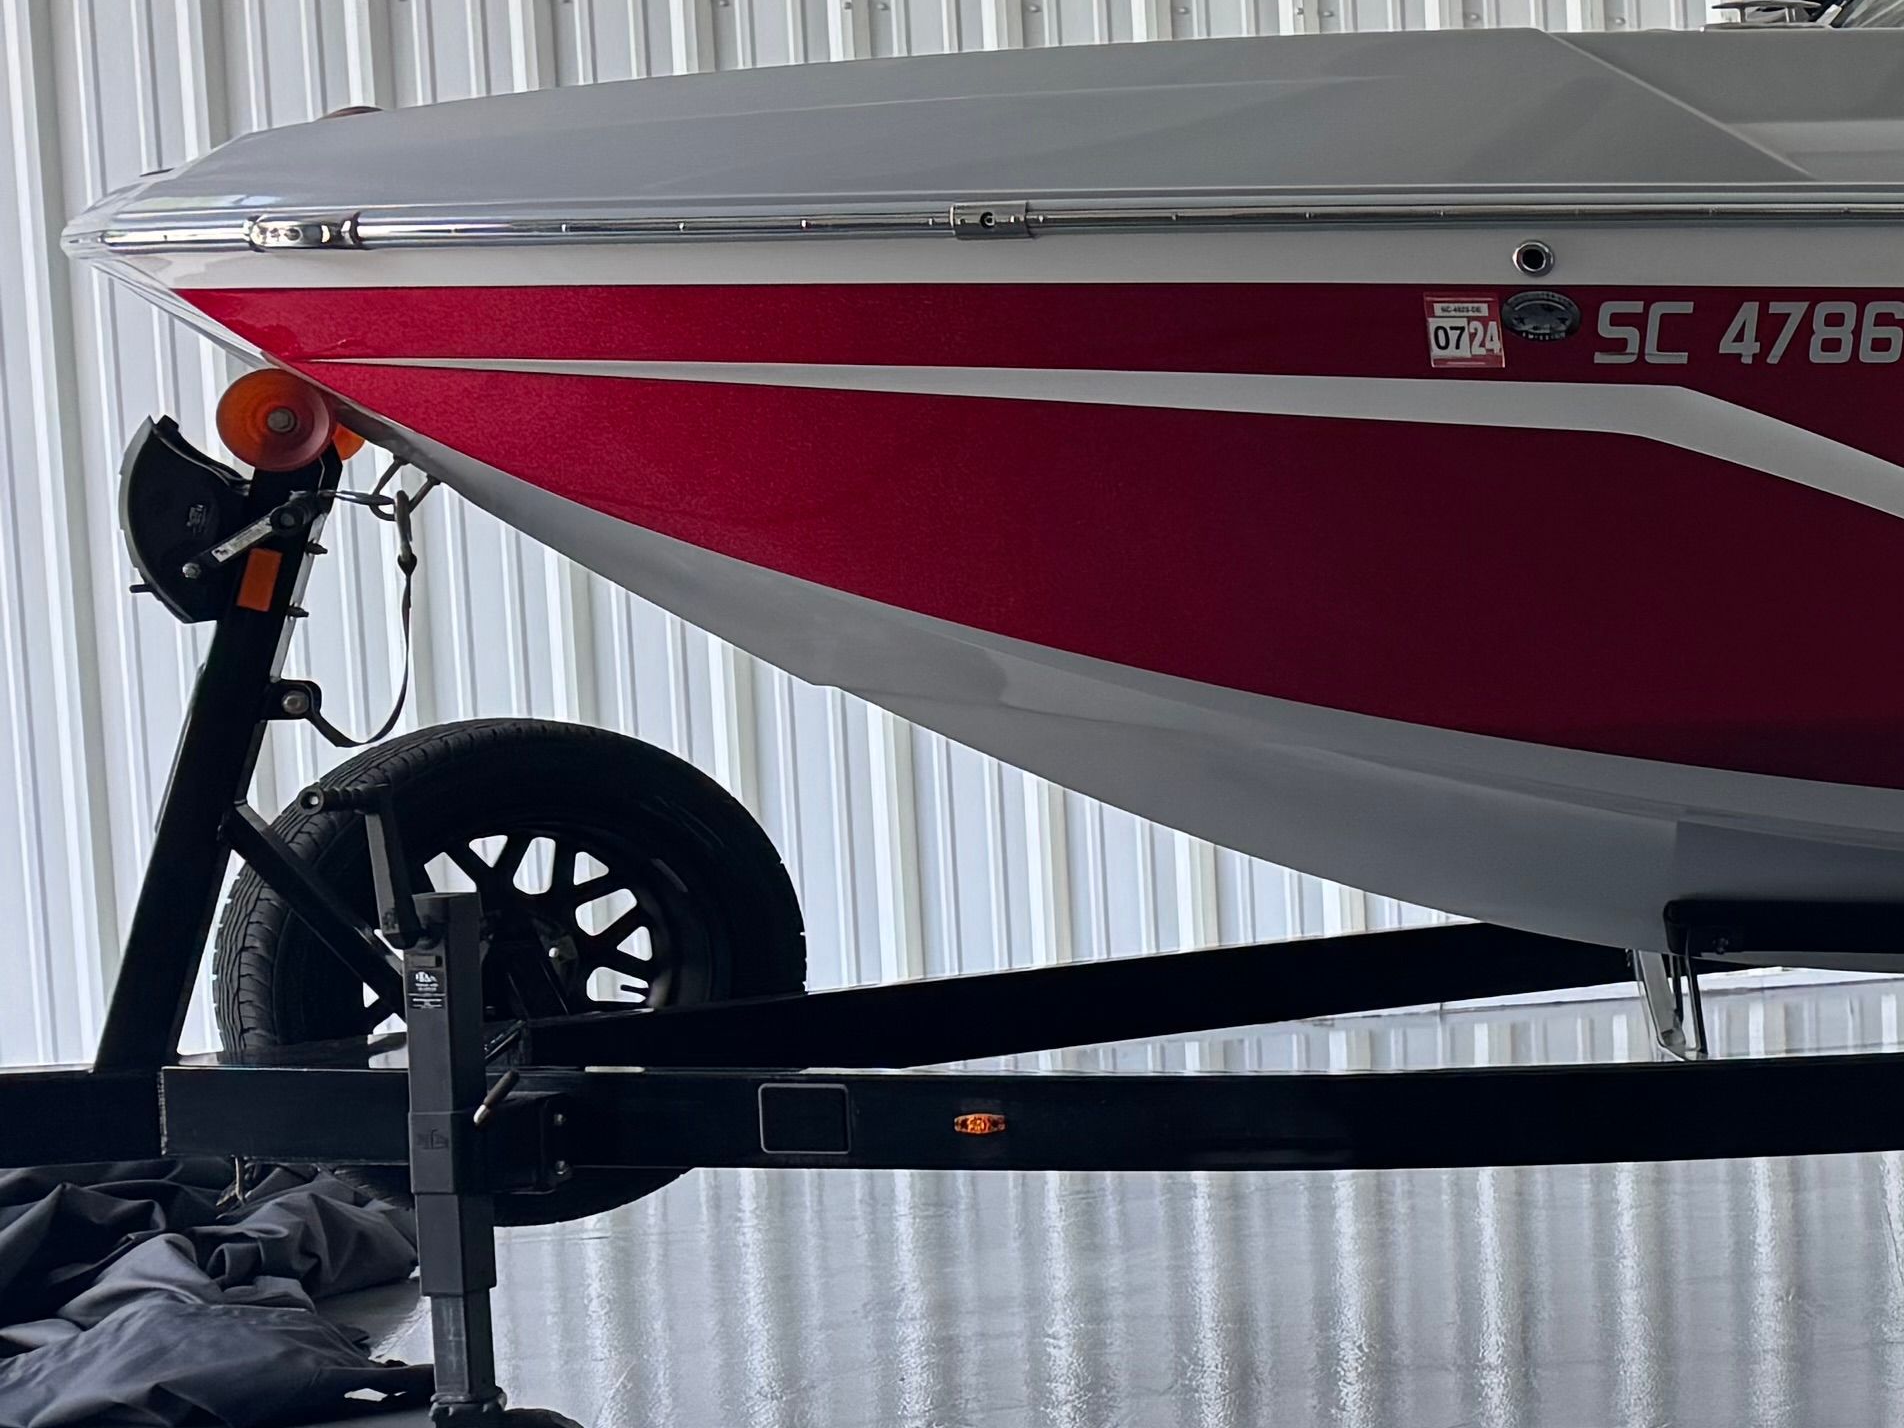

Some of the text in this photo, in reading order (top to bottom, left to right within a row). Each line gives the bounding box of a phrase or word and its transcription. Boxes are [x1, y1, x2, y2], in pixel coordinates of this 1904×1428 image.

[1433, 321, 1502, 356] 07 24
[1594, 301, 1694, 365] SC
